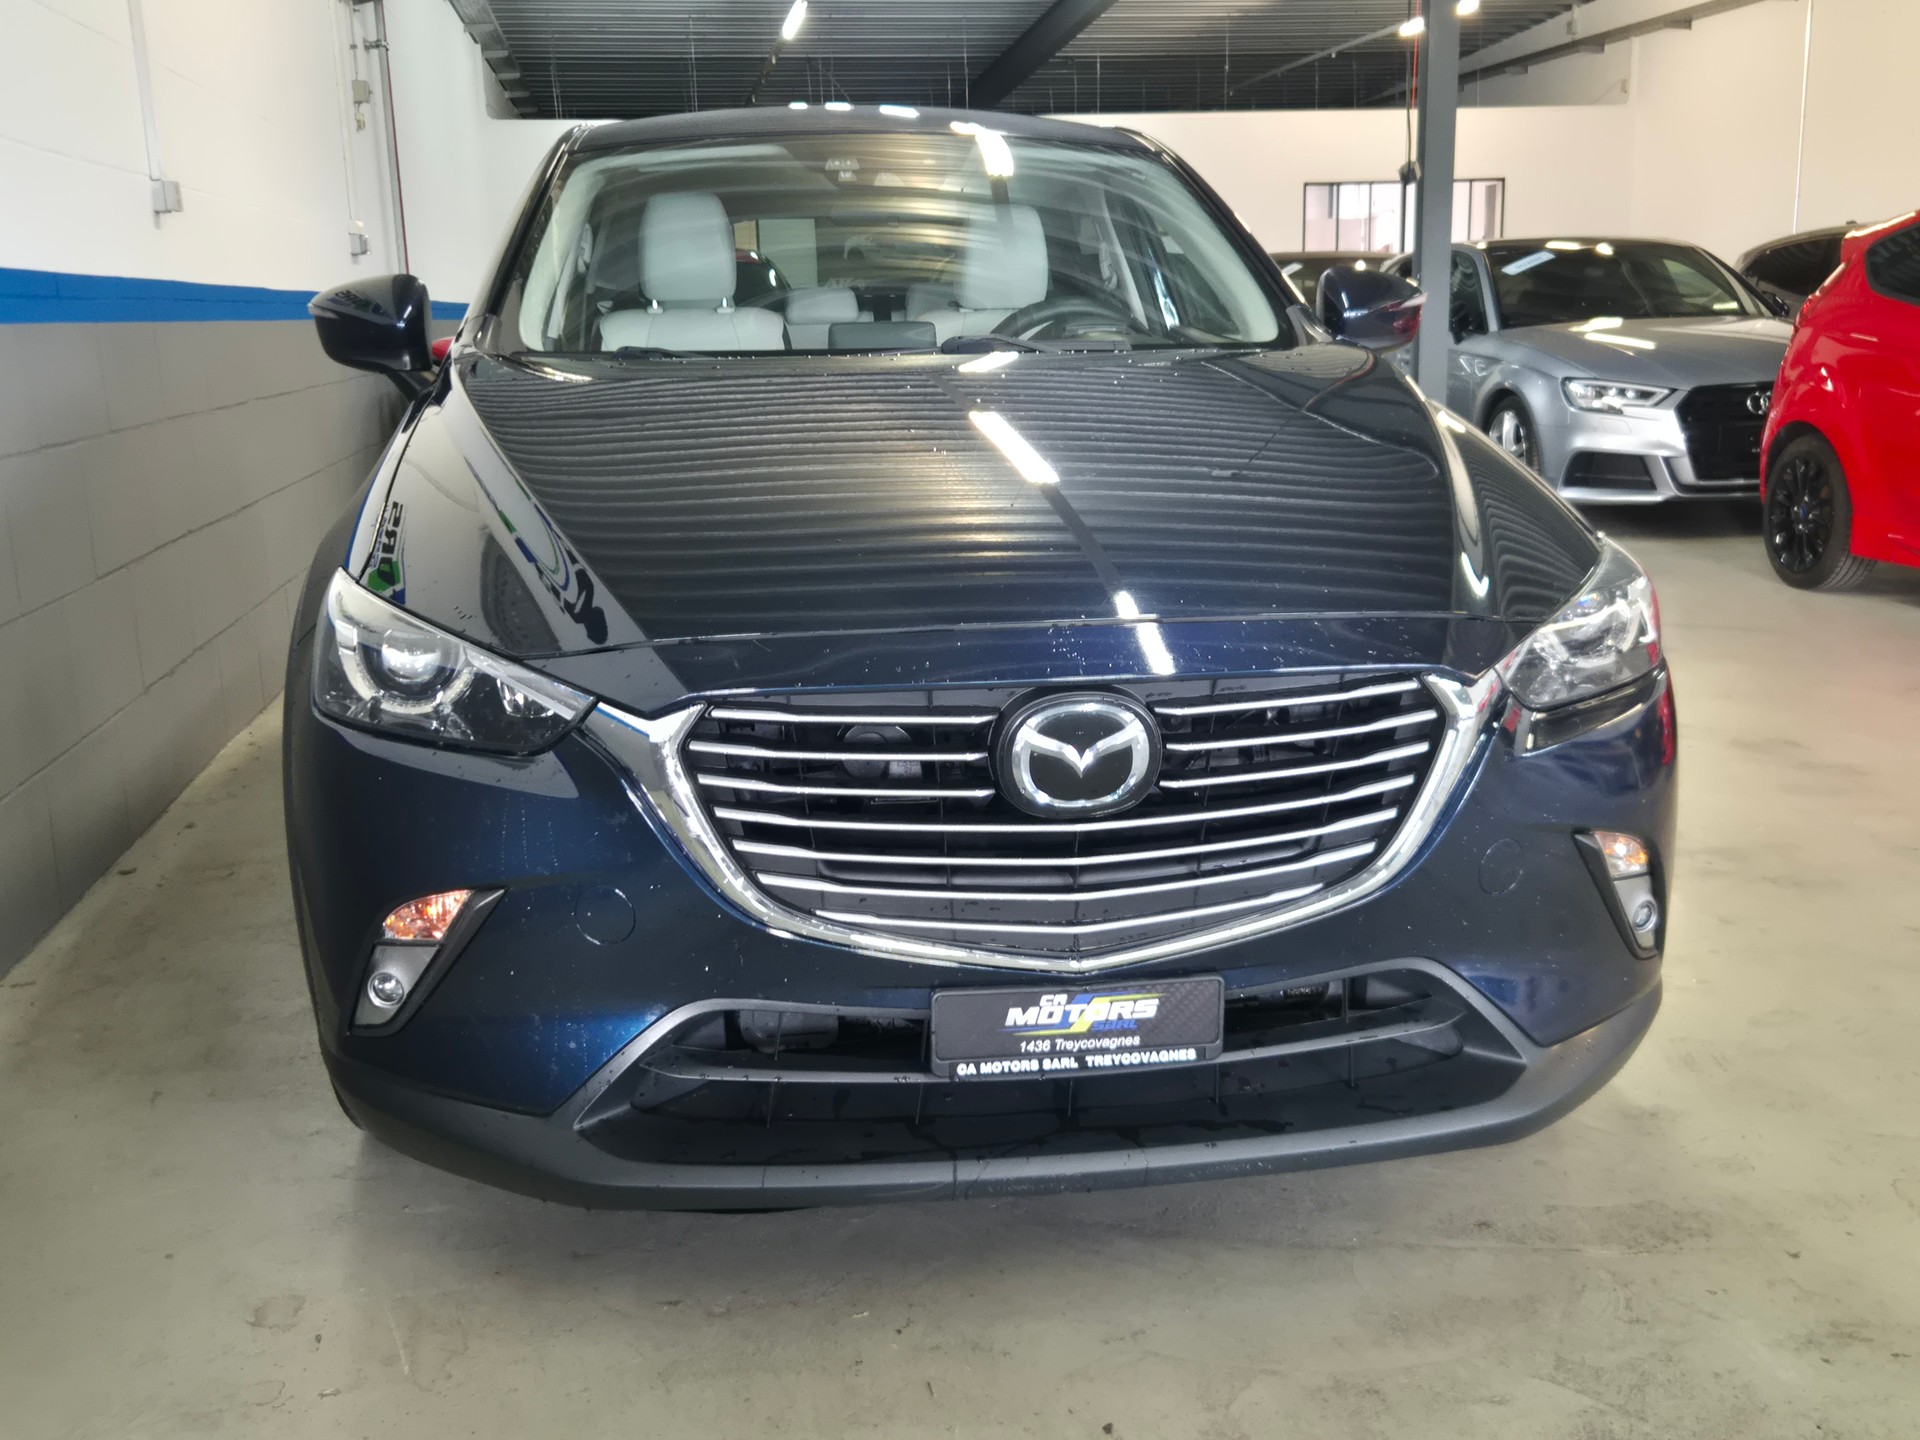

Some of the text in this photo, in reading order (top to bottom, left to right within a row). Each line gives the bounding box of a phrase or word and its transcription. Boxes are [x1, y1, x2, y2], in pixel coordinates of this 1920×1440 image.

[1005, 999, 1159, 1026] MOTORS
[1020, 1035, 1140, 1053] 1436 Treycovagnes
[980, 1059, 1039, 1074] MOTORS
[1042, 1057, 1078, 1070] SARL
[1085, 1048, 1197, 1067] TREYCOVAGNES
